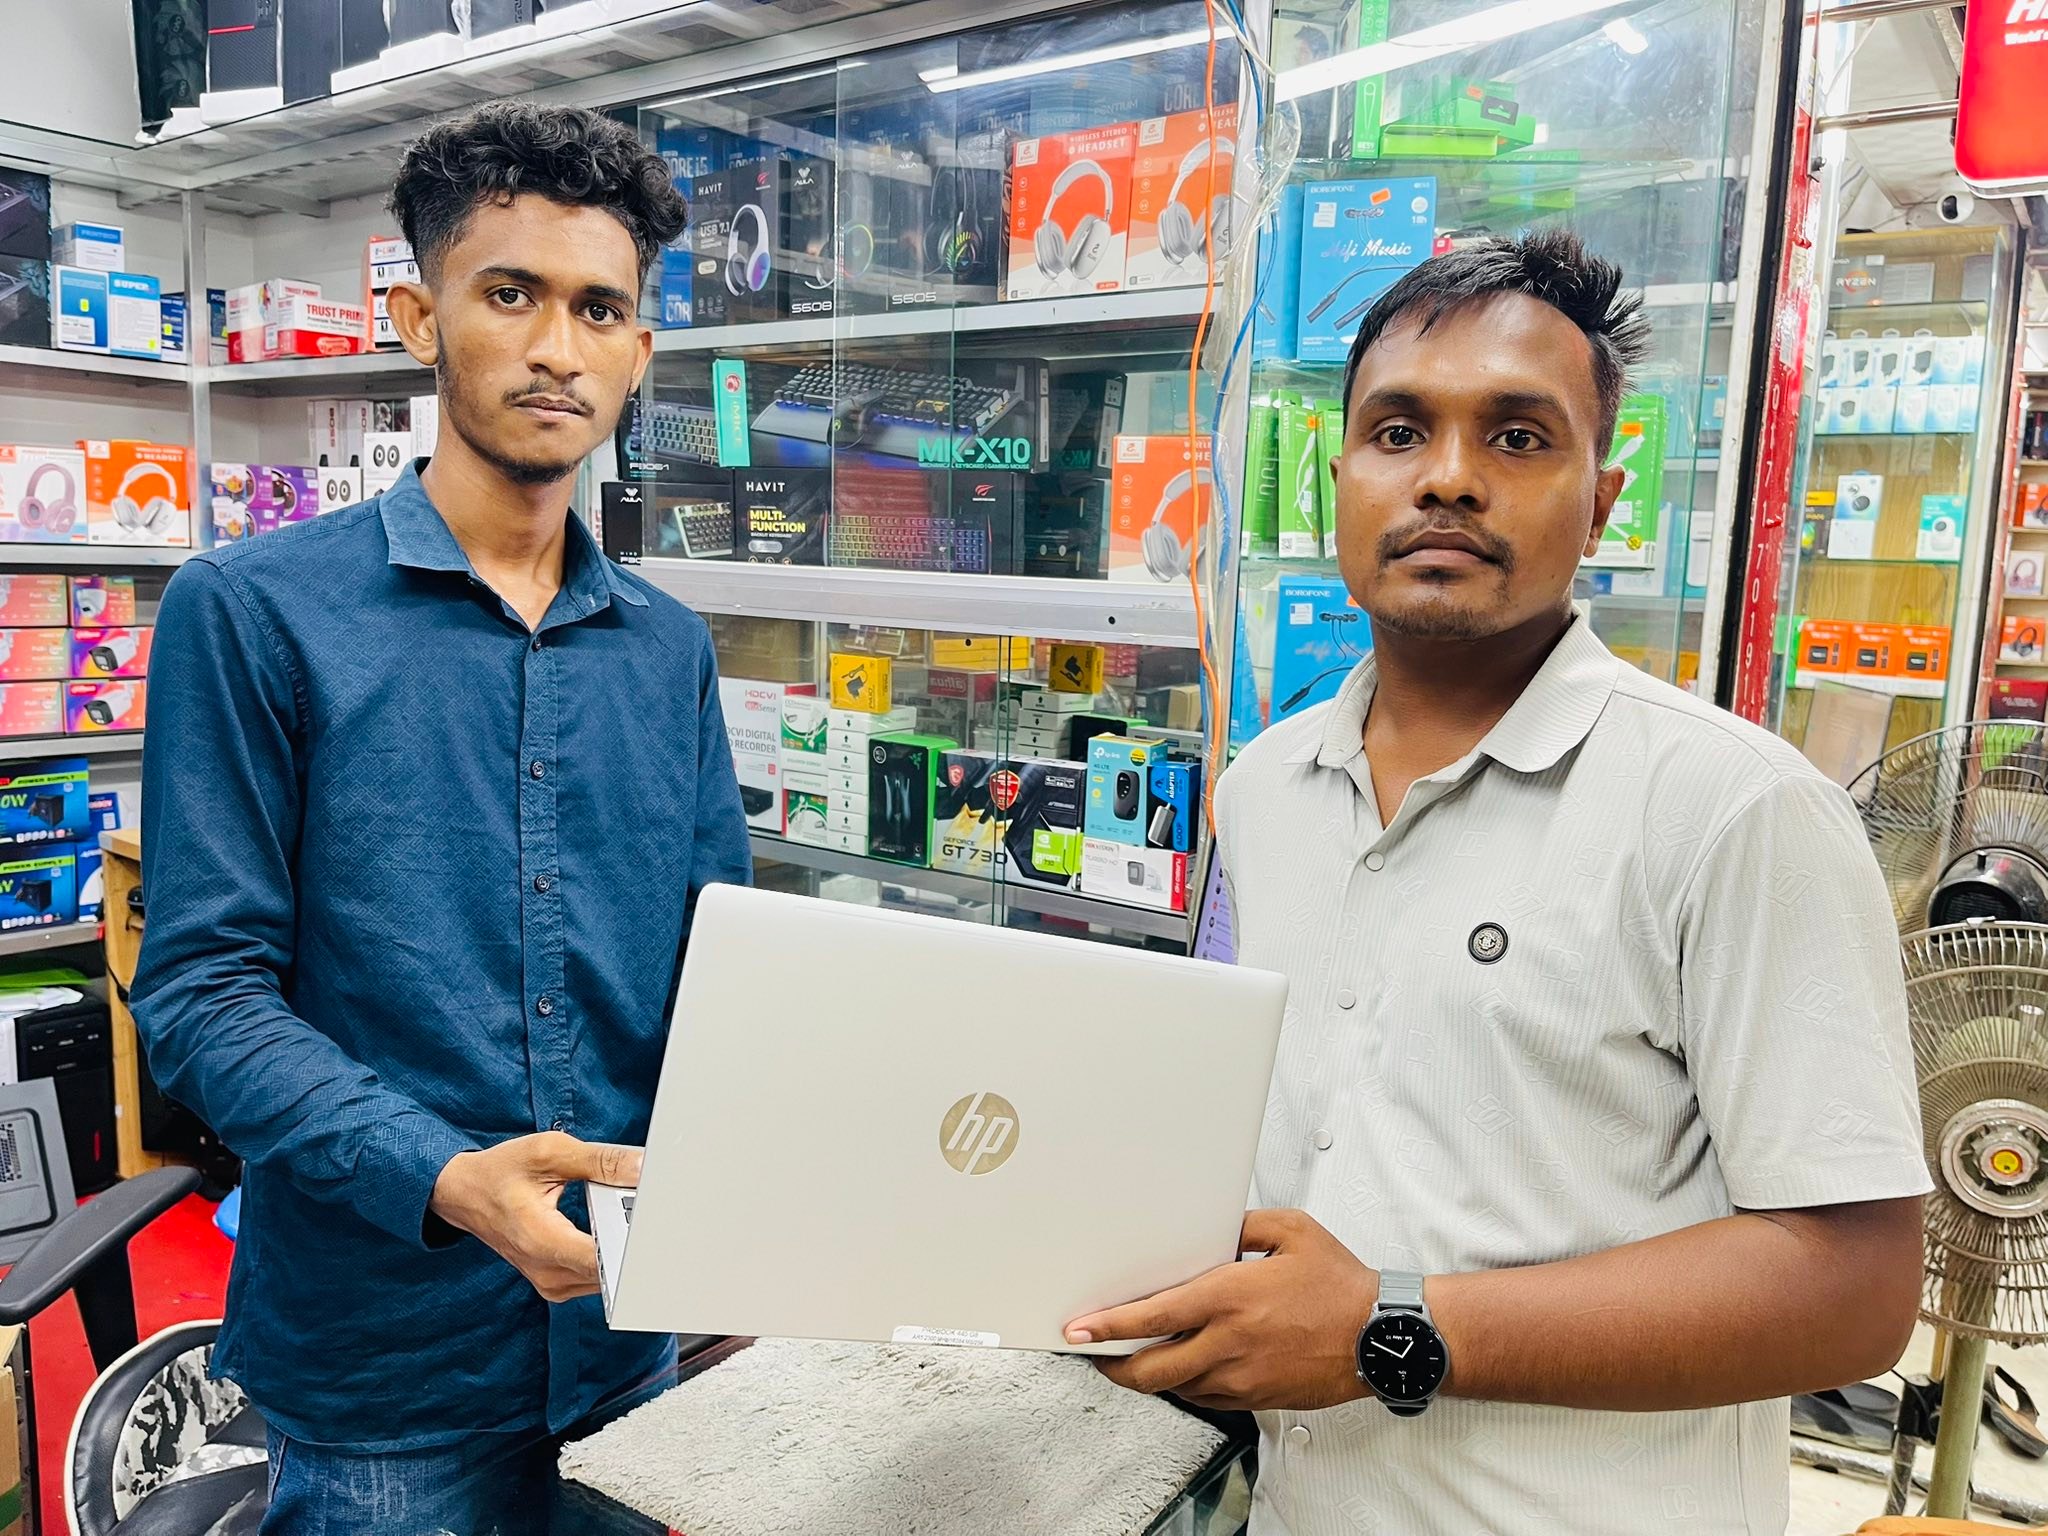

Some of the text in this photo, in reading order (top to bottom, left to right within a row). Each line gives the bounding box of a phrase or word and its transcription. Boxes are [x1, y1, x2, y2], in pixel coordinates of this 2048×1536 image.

[1070, 128, 1127, 142] WIRELESS STEREO
[1077, 139, 1126, 153] HEADSET
[794, 177, 814, 186] AULA
[698, 182, 722, 196] HAVIT
[1310, 185, 1355, 194] BOROFONE
[700, 221, 730, 237] USB 7.1
[1362, 239, 1412, 257] Music
[1836, 277, 1876, 287] RYZEN
[892, 291, 937, 305] S605
[306, 304, 336, 317] TRUST
[666, 302, 692, 322] COR
[791, 301, 833, 313] S608
[918, 437, 1031, 464] MK-X10
[143, 453, 183, 462] HEADSET
[746, 481, 785, 493] HAVIT
[750, 510, 786, 522] MULTI-
[750, 521, 806, 533] FUNCTION
[1285, 588, 1331, 598] BOROFONE
[745, 689, 777, 700] HDCVI
[745, 729, 777, 743] DIGITAL
[734, 740, 777, 754] RECORDER
[943, 836, 976, 846] GEFORCE
[942, 843, 1009, 865] GT 730
[943, 1092, 1016, 1175] hp
